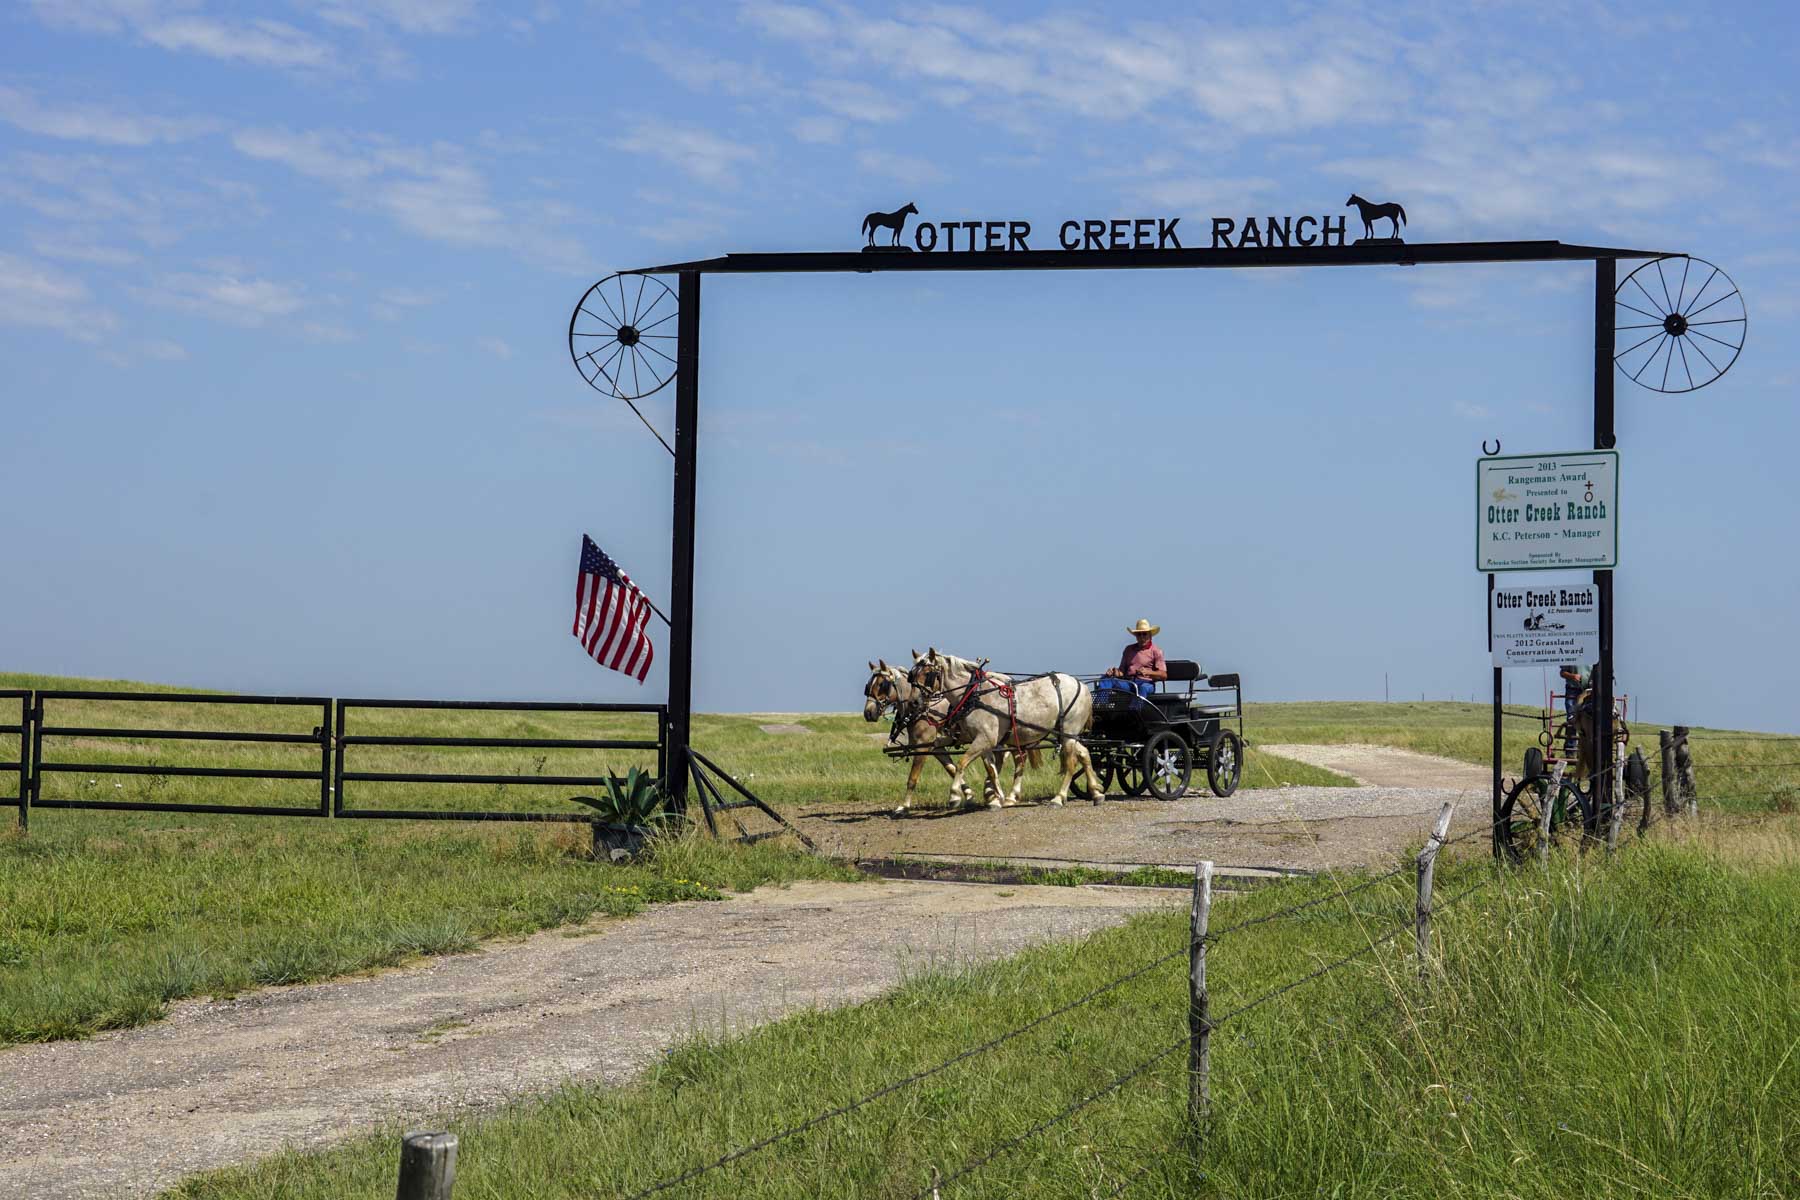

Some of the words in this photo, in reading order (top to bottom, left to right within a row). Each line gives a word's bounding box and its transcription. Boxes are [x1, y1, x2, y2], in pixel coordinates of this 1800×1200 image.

[915, 220, 1031, 252] OTTER
[1059, 217, 1181, 250] CREEK
[1211, 215, 1346, 248] RANCH
[1537, 462, 1557, 471] 2013
[1508, 474, 1556, 485] Rangemans
[1560, 472, 1586, 481] Award
[1526, 489, 1558, 497] Presented
[1488, 505, 1519, 524] Otter
[1526, 502, 1561, 522] Creek
[1567, 500, 1606, 520] Ranch
[1492, 532, 1511, 541] K.C.
[1514, 531, 1550, 540] Peterson
[1562, 529, 1601, 539] Manager
[1496, 592, 1523, 608] Otter
[1526, 590, 1557, 607] Creek
[1560, 588, 1593, 606] Ranch
[1515, 639, 1534, 647] 2012
[1536, 638, 1575, 646] Grassland
[1506, 648, 1556, 656] Conservation
[1558, 647, 1584, 655] Award
